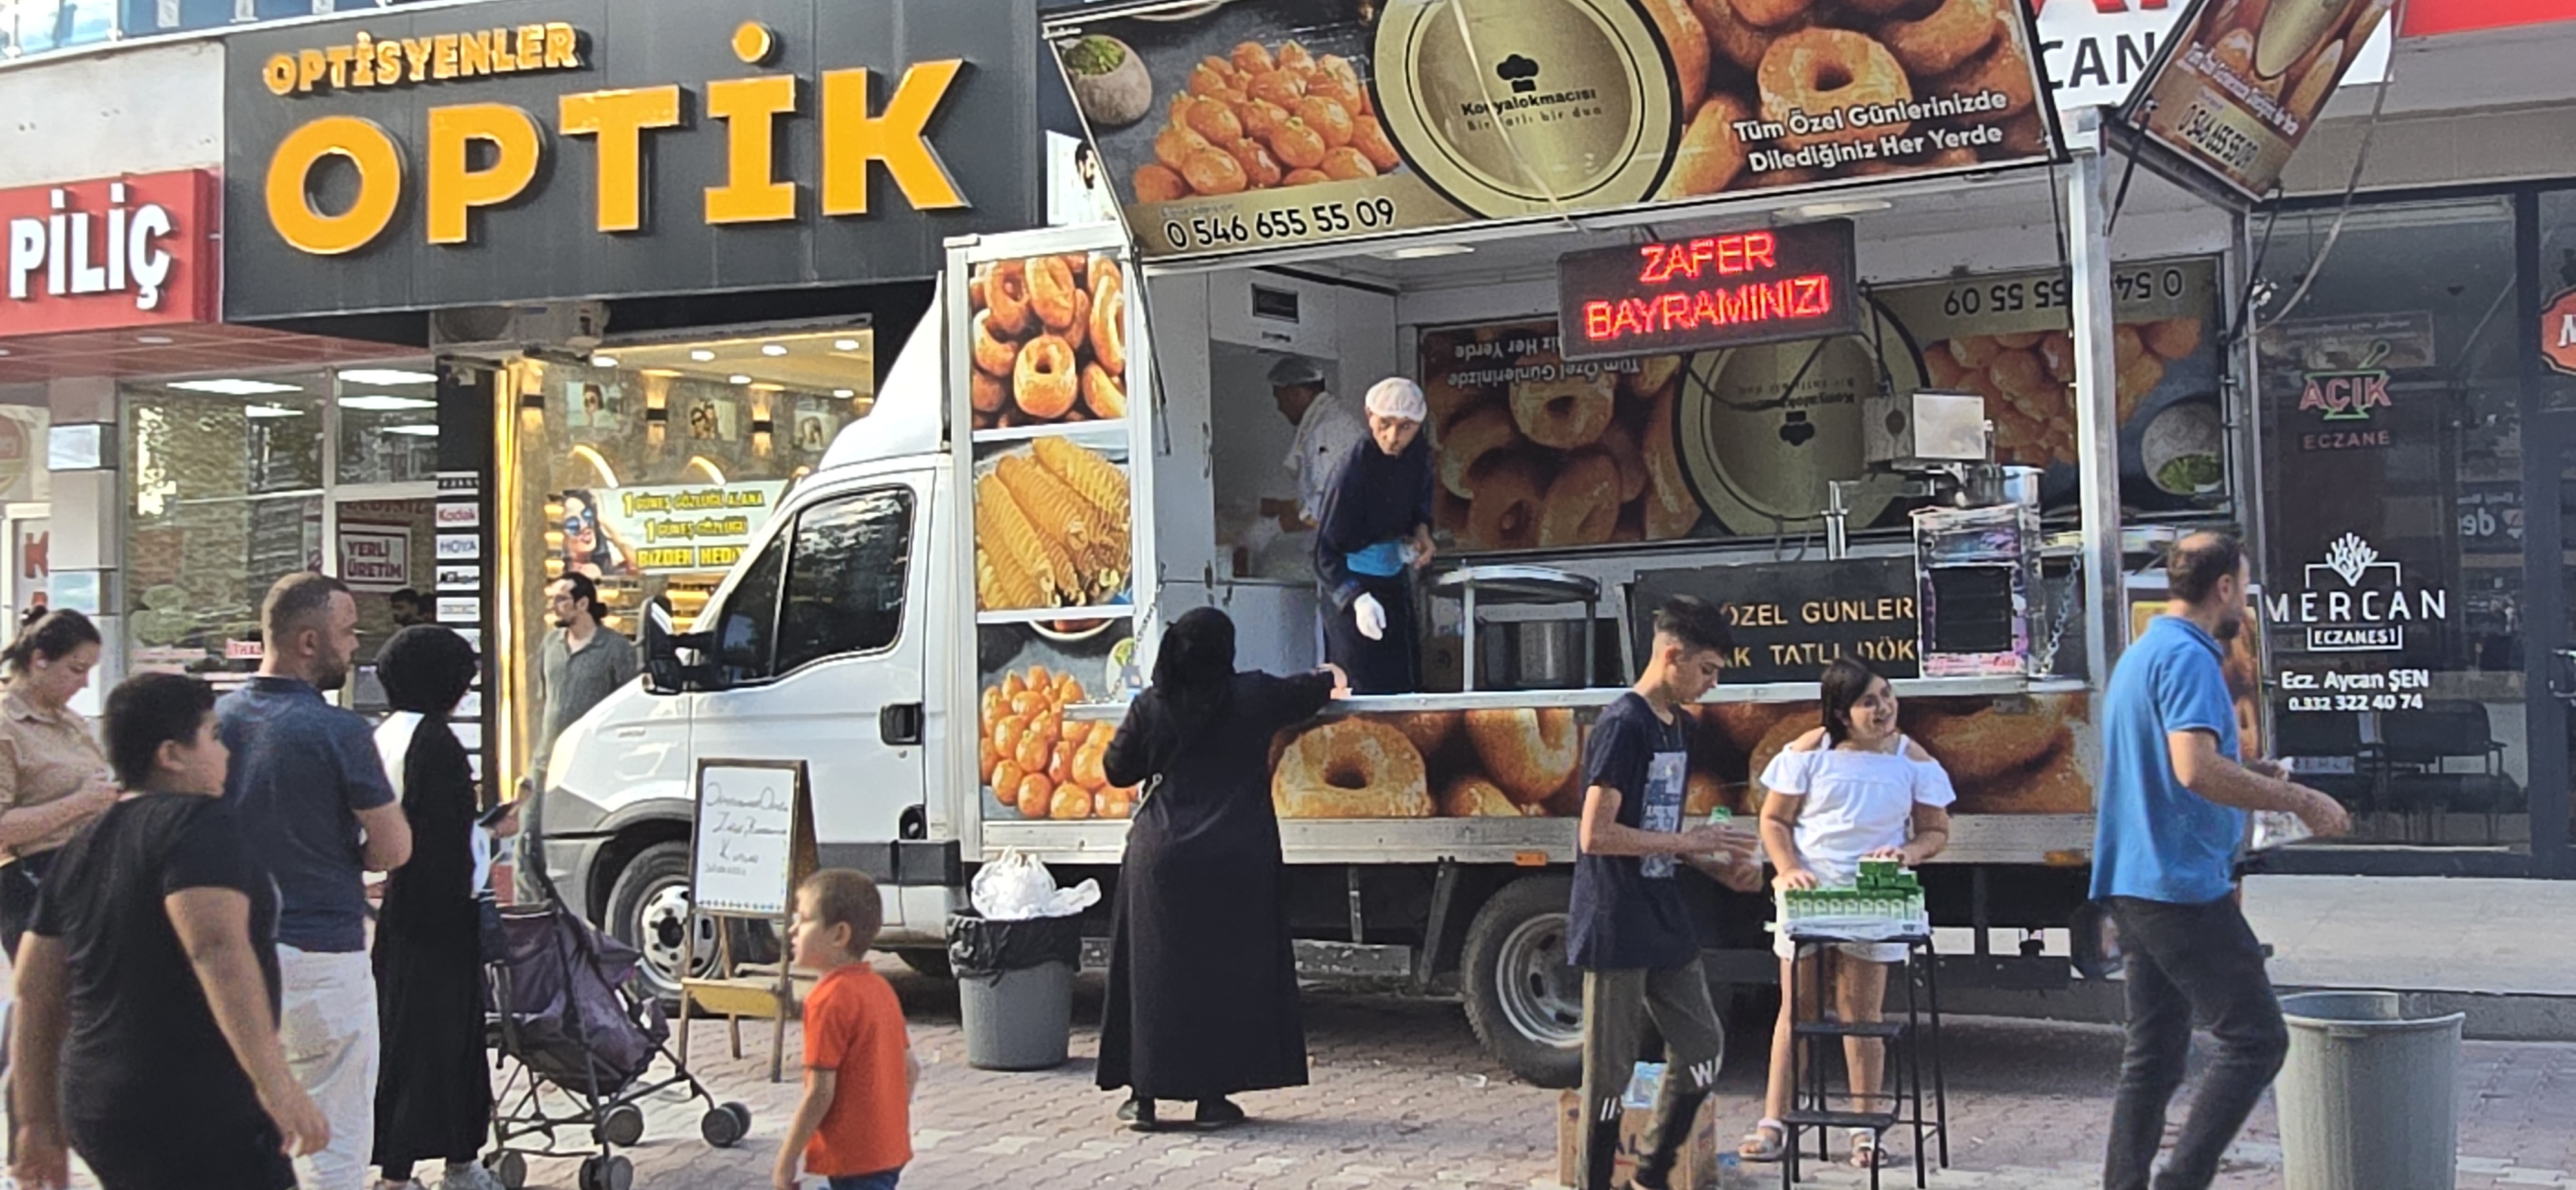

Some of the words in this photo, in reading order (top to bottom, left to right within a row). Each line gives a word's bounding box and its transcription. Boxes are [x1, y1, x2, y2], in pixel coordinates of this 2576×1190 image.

[263, 23, 578, 95] OPTİSYENLER
[1733, 120, 1785, 142] Tüm
[1789, 109, 1844, 135] Özel
[1848, 90, 2007, 127] Günlerinizde
[266, 21, 971, 254] OPTİK
[1748, 139, 1877, 173] Dilediğiniz
[1880, 135, 1924, 156] Her
[1927, 124, 2003, 149] Yerde
[1167, 222, 1188, 248] 0
[1193, 214, 1249, 245] 546
[1256, 208, 1307, 239] 655
[1312, 203, 1350, 232] 55
[1356, 198, 1394, 227] 09
[9, 182, 172, 310] PİLİÇ
[1640, 231, 1777, 284] ZAFER
[1990, 283, 2023, 312] 55
[2032, 279, 2067, 308] 55
[2113, 271, 2152, 301] 54
[2163, 269, 2183, 298] 0
[1944, 287, 1980, 316] 09
[1455, 341, 1504, 361] Yerde
[1447, 364, 1556, 389] Günlerinizde
[2303, 430, 2391, 450] ECZANE
[438, 508, 477, 522] Kodak
[439, 540, 477, 554] HOYA
[2265, 589, 2446, 623] MERCAN
[2323, 670, 2385, 692] Aycan
[2388, 668, 2430, 692] ŞEN
[2334, 695, 2370, 711] 322
[2372, 694, 2397, 710] 40
[2399, 692, 2424, 710] 74
